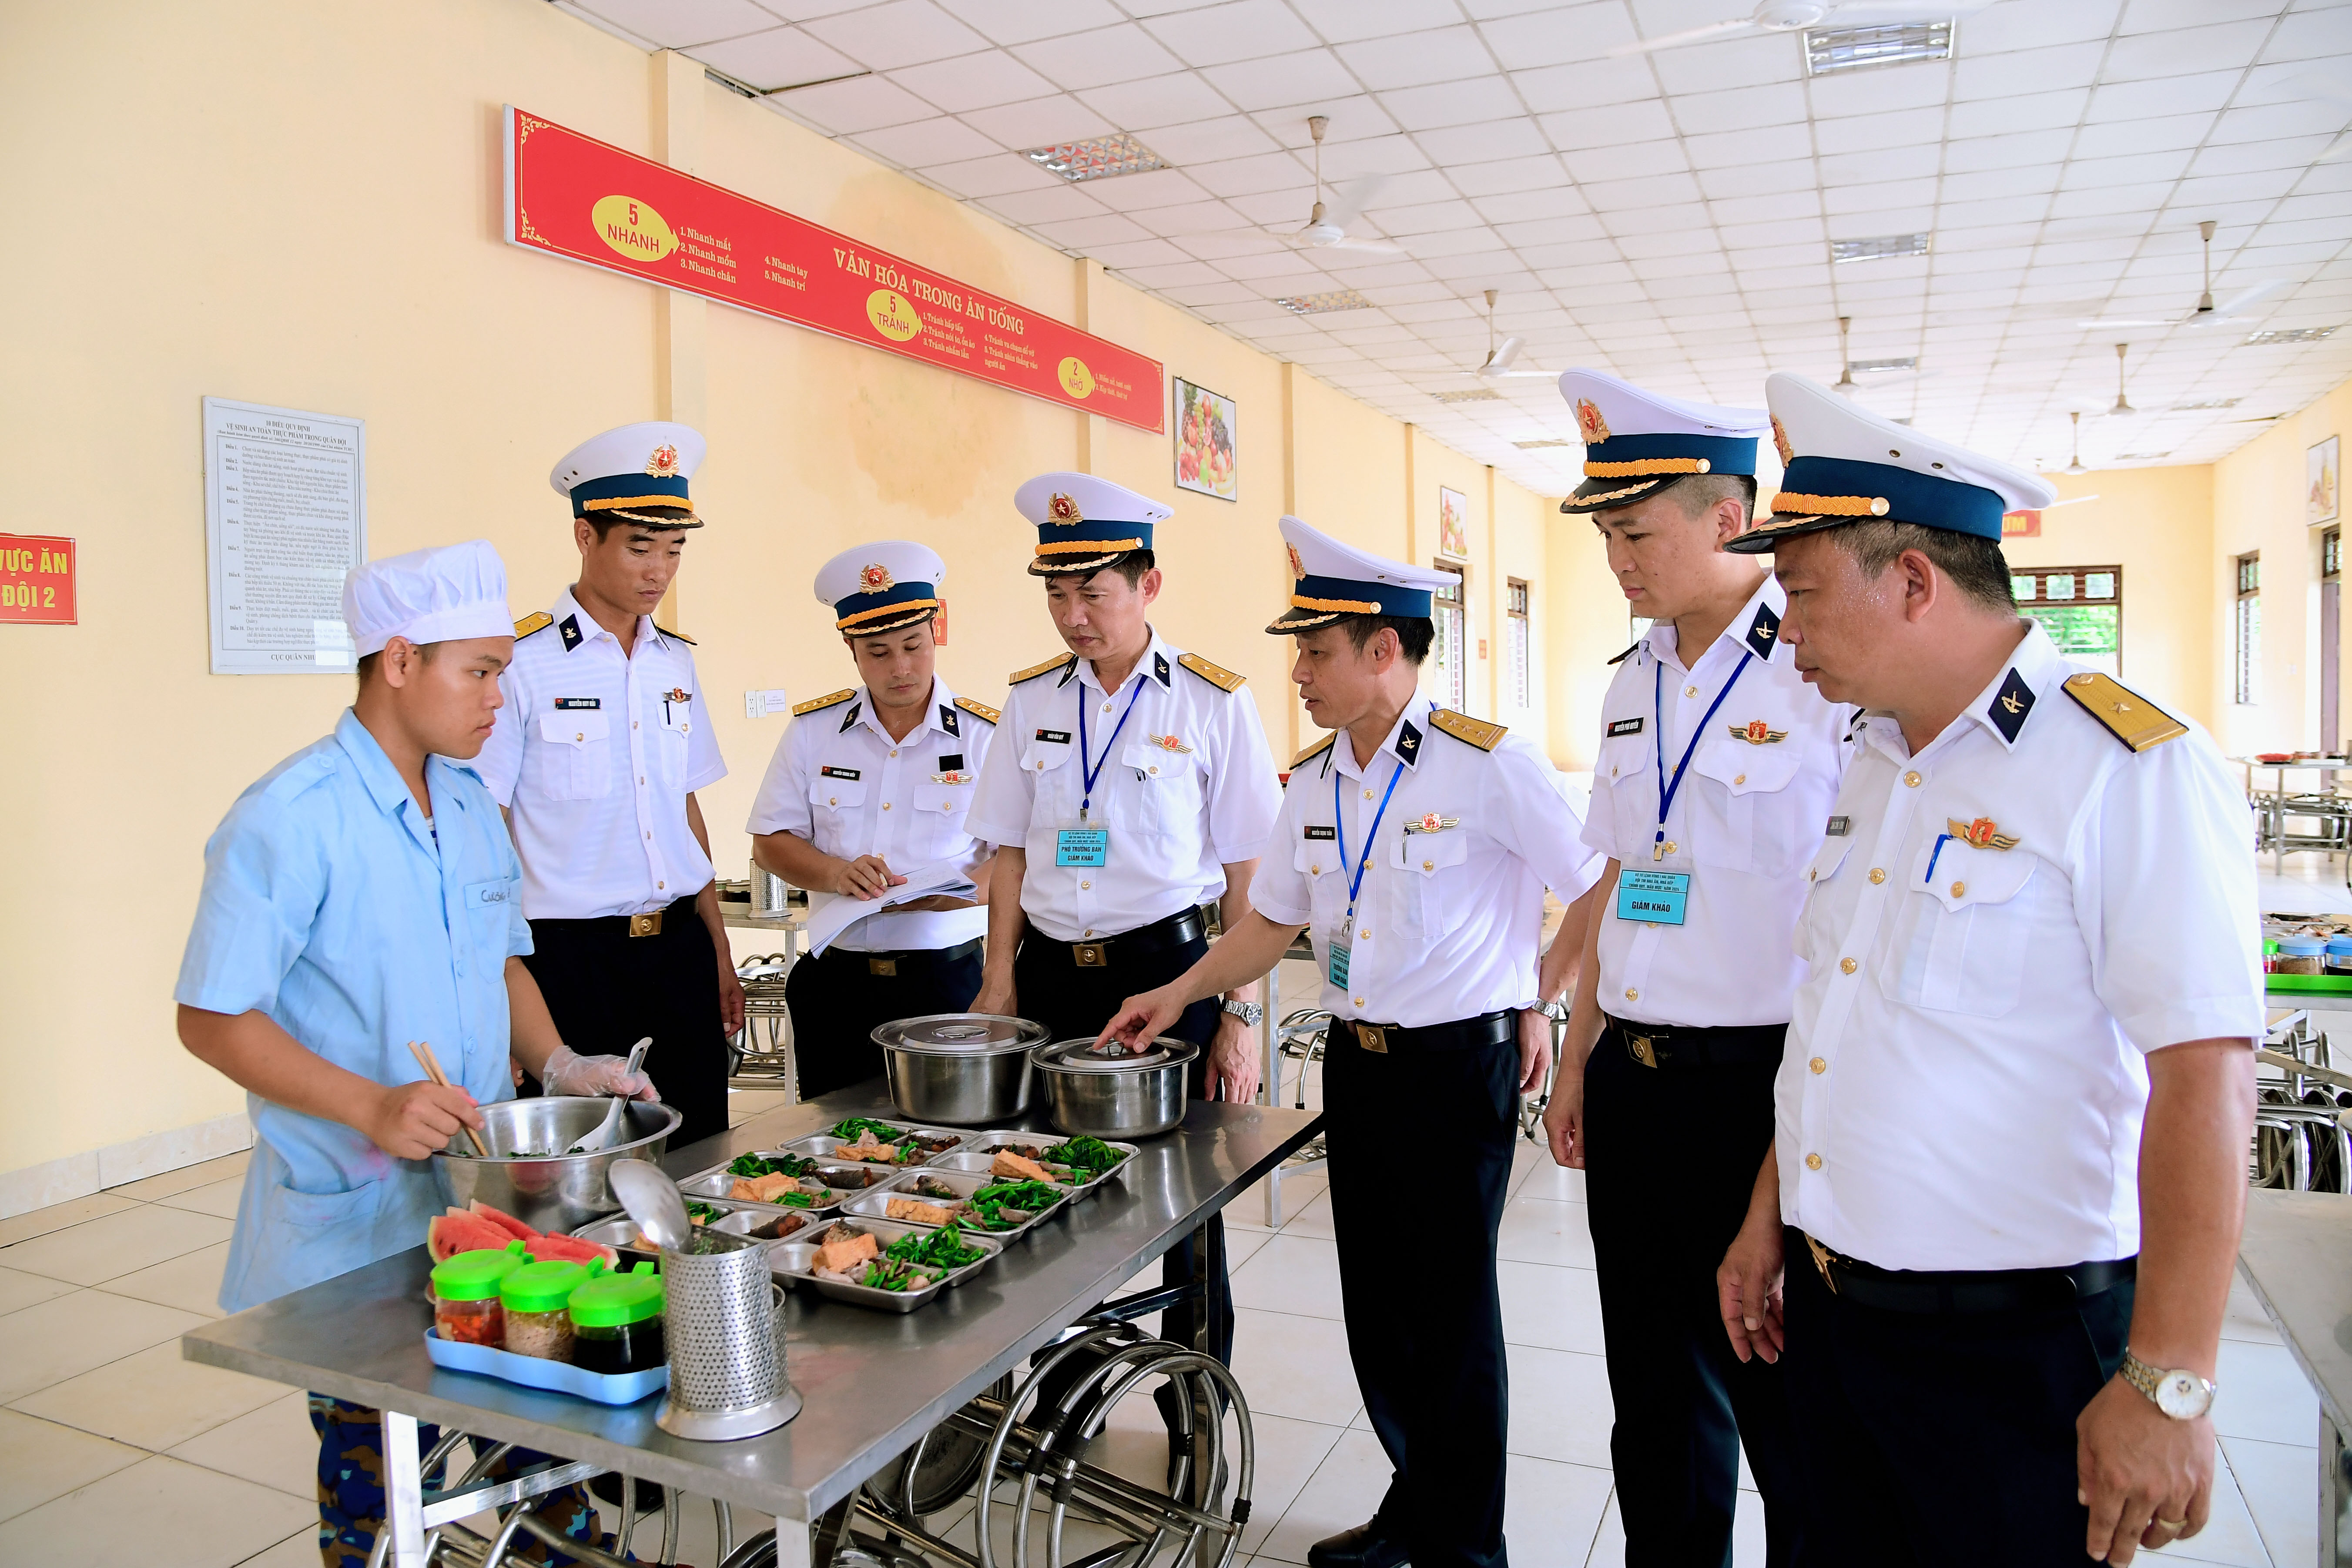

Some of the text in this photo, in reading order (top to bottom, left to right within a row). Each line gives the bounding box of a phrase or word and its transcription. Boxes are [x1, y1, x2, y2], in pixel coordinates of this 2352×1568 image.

[629, 203, 638, 225] 5
[608, 224, 659, 253] NHANH
[680, 226, 731, 251] 1. Nhanh mắt
[680, 242, 687, 253] 2.
[688, 244, 716, 261] Nhanh
[680, 259, 736, 284] 3. Nhanh chân
[764, 257, 808, 279] 4. Nhanh tay
[764, 271, 806, 291] 5. Nhanh trí
[834, 247, 1025, 335] VĂN HÓA TRONG ĂN UỐNG
[889, 295, 896, 313] 5
[877, 312, 909, 334] TRÁNH
[927, 313, 944, 326] Tránh
[928, 326, 945, 339] Tránh
[928, 338, 945, 352] Tránh
[1073, 362, 1078, 376] 2
[1069, 378, 1083, 391] NHỚ
[285, 423, 296, 431] QUY
[39, 547, 67, 574] ĂN
[2, 580, 55, 612] ĐỘI 2
[1081, 853, 1094, 861] KHẢO
[1632, 900, 1671, 912] GIÁM KHẢO
